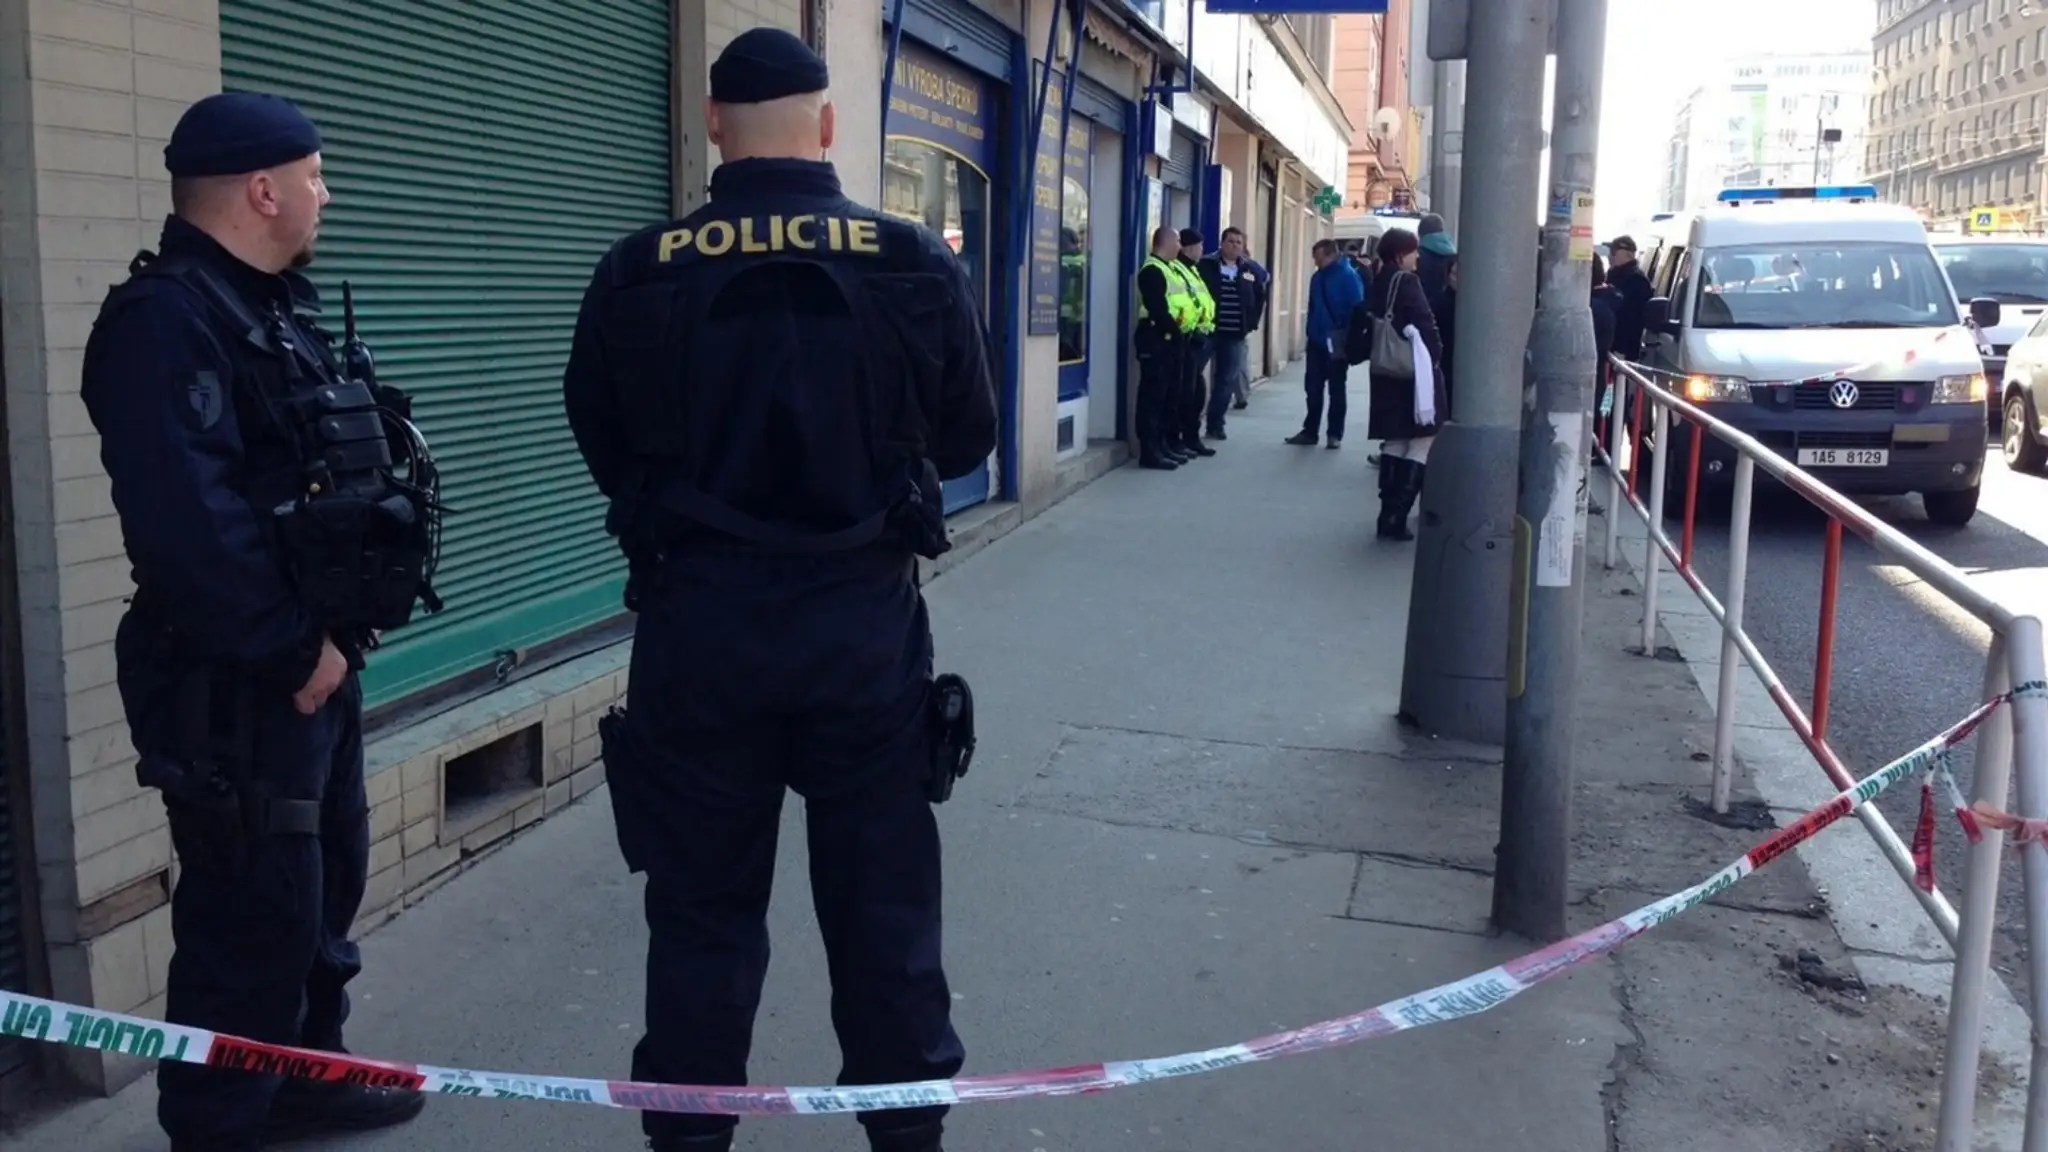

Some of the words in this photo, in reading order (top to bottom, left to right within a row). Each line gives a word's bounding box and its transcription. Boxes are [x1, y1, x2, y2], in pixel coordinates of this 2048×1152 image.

[658, 214, 880, 263] POLICIE
[1811, 451, 1836, 464] 1A5
[1846, 451, 1882, 464] 8129
